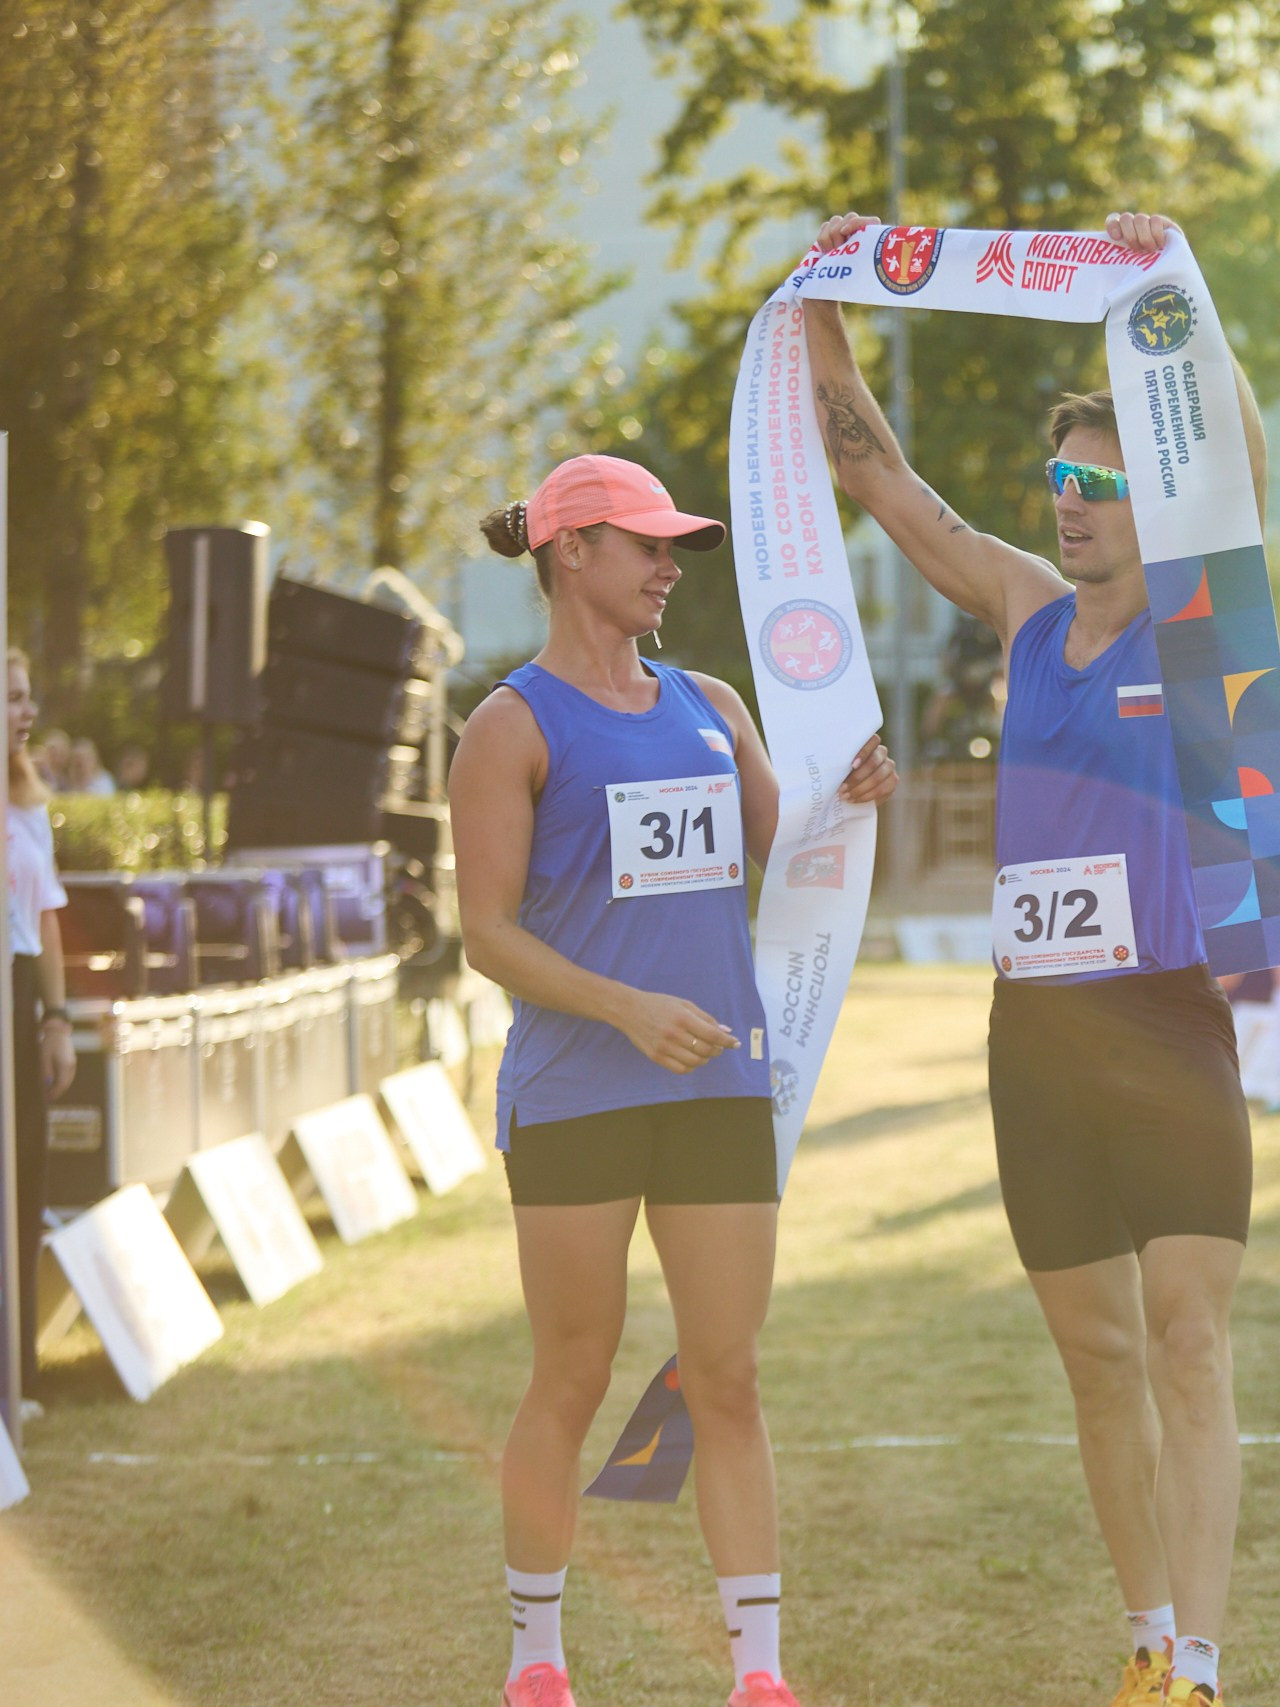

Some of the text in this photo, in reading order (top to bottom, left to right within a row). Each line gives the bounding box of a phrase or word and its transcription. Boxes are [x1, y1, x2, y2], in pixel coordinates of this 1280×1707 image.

[818, 266, 852, 279] CUP
[1021, 261, 1078, 293] СПОРТ
[1162, 365, 1189, 465] СОВРЕМЕННОГО
[1182, 360, 1206, 441] ФЕДЕРАЦИЯ
[1144, 370, 1177, 498] ПЯТИБОРЬЯ РОССИИ
[640, 806, 715, 860] 3/1
[1013, 889, 1102, 943] 3/2
